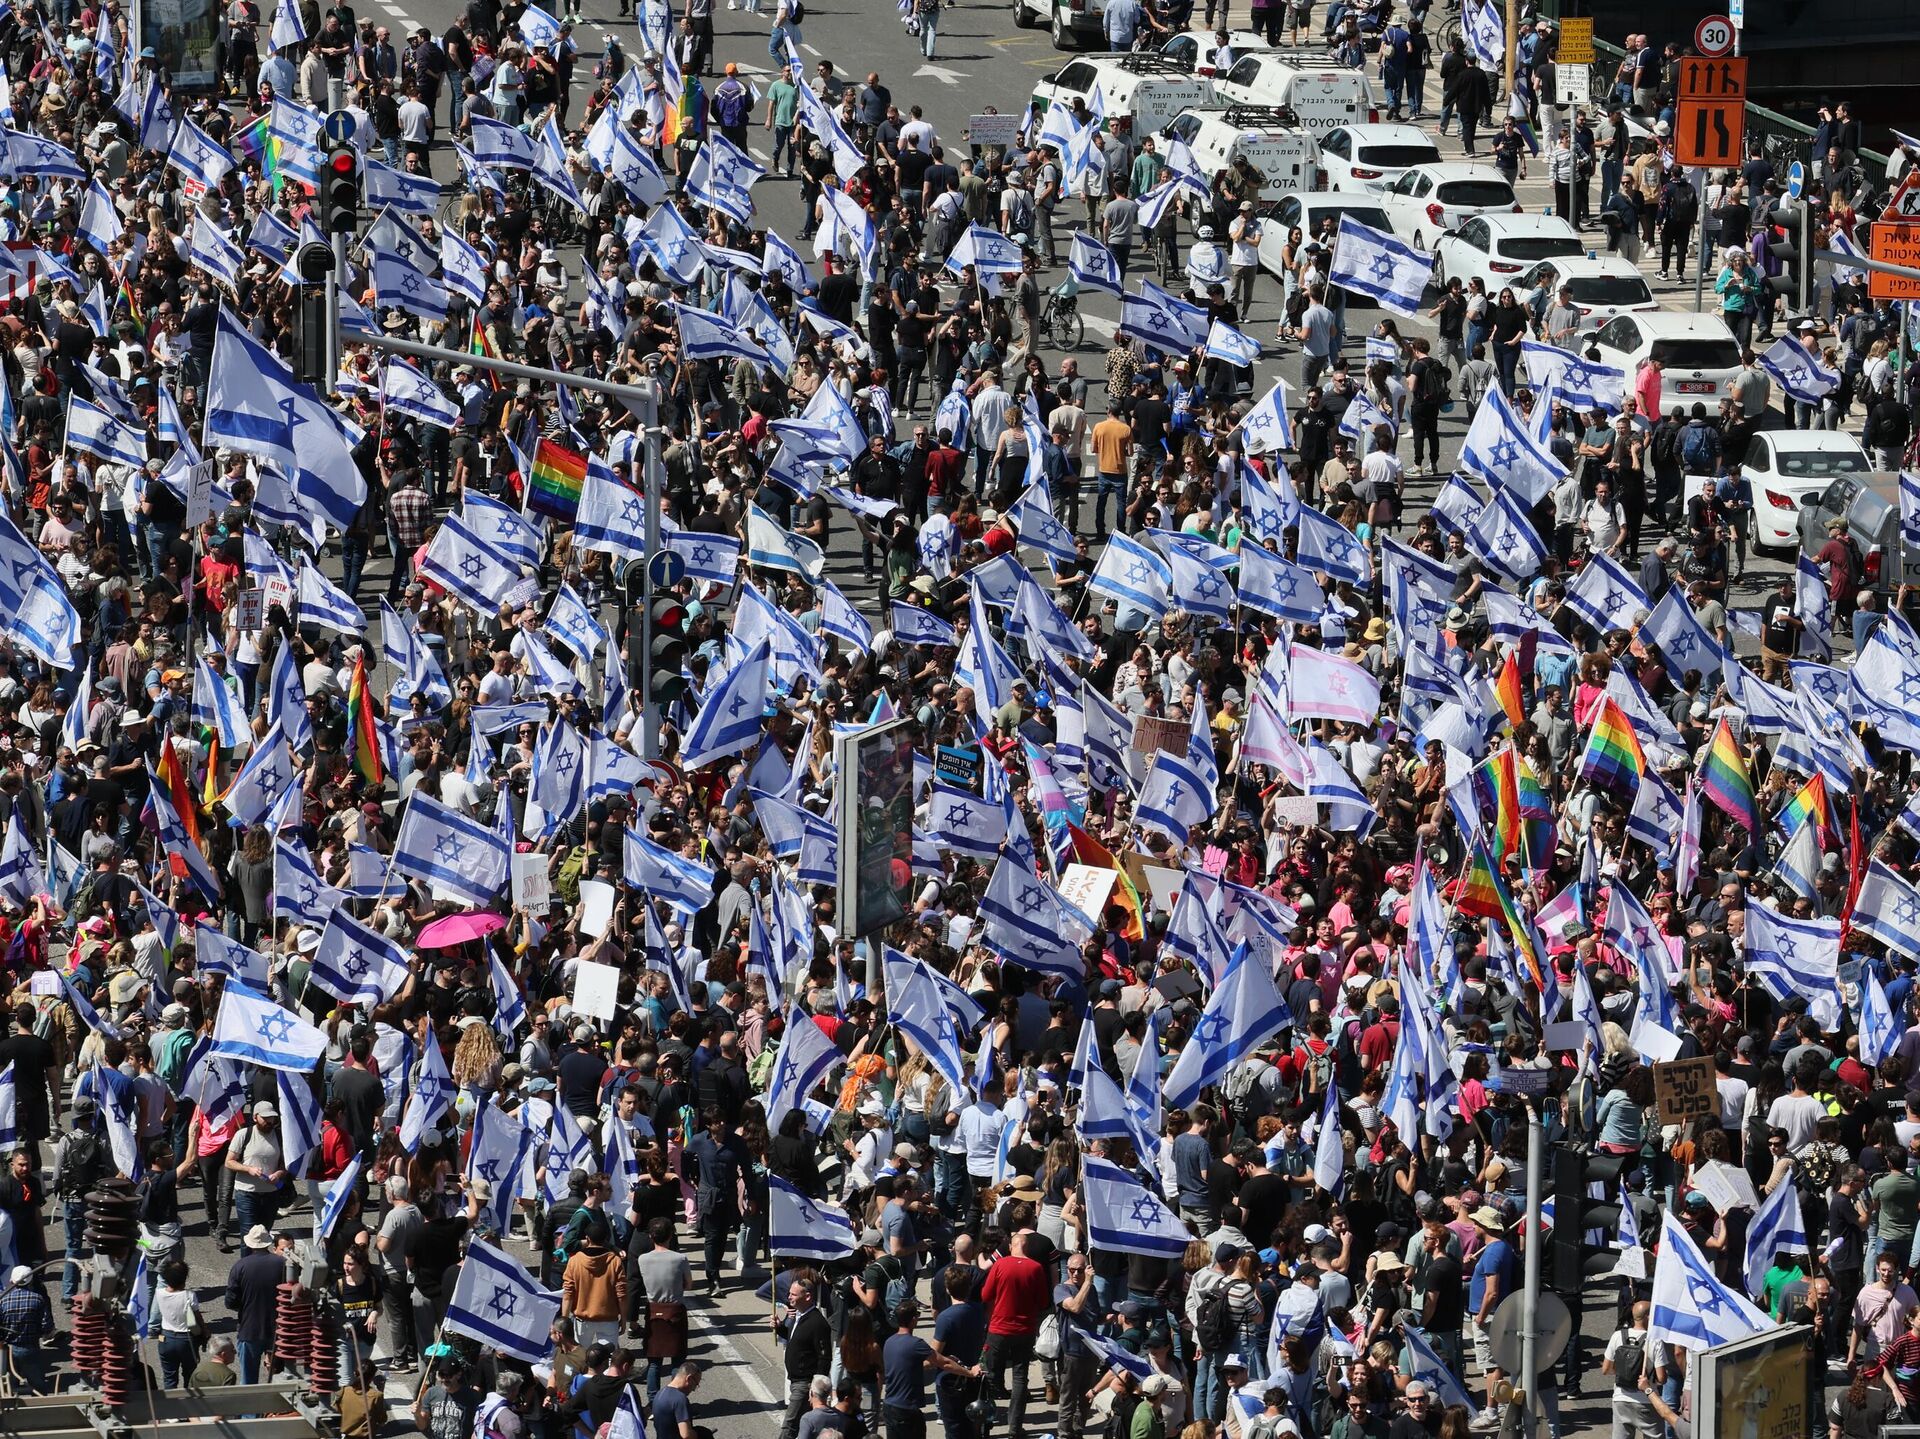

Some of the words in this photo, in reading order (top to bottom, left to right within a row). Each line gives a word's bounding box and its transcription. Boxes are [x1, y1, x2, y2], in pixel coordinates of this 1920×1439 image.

[1705, 29, 1725, 44] 30
[1154, 108, 1165, 116] 60
[1301, 117, 1350, 128] TOYOTA
[1247, 148, 1272, 156] הגבול
[941, 753, 960, 765] חופש
[960, 759, 972, 769] אין
[938, 762, 959, 775] הייטק
[958, 769, 970, 778] אין
[1672, 1080, 1699, 1097] של
[1667, 1094, 1711, 1115] כולנו
